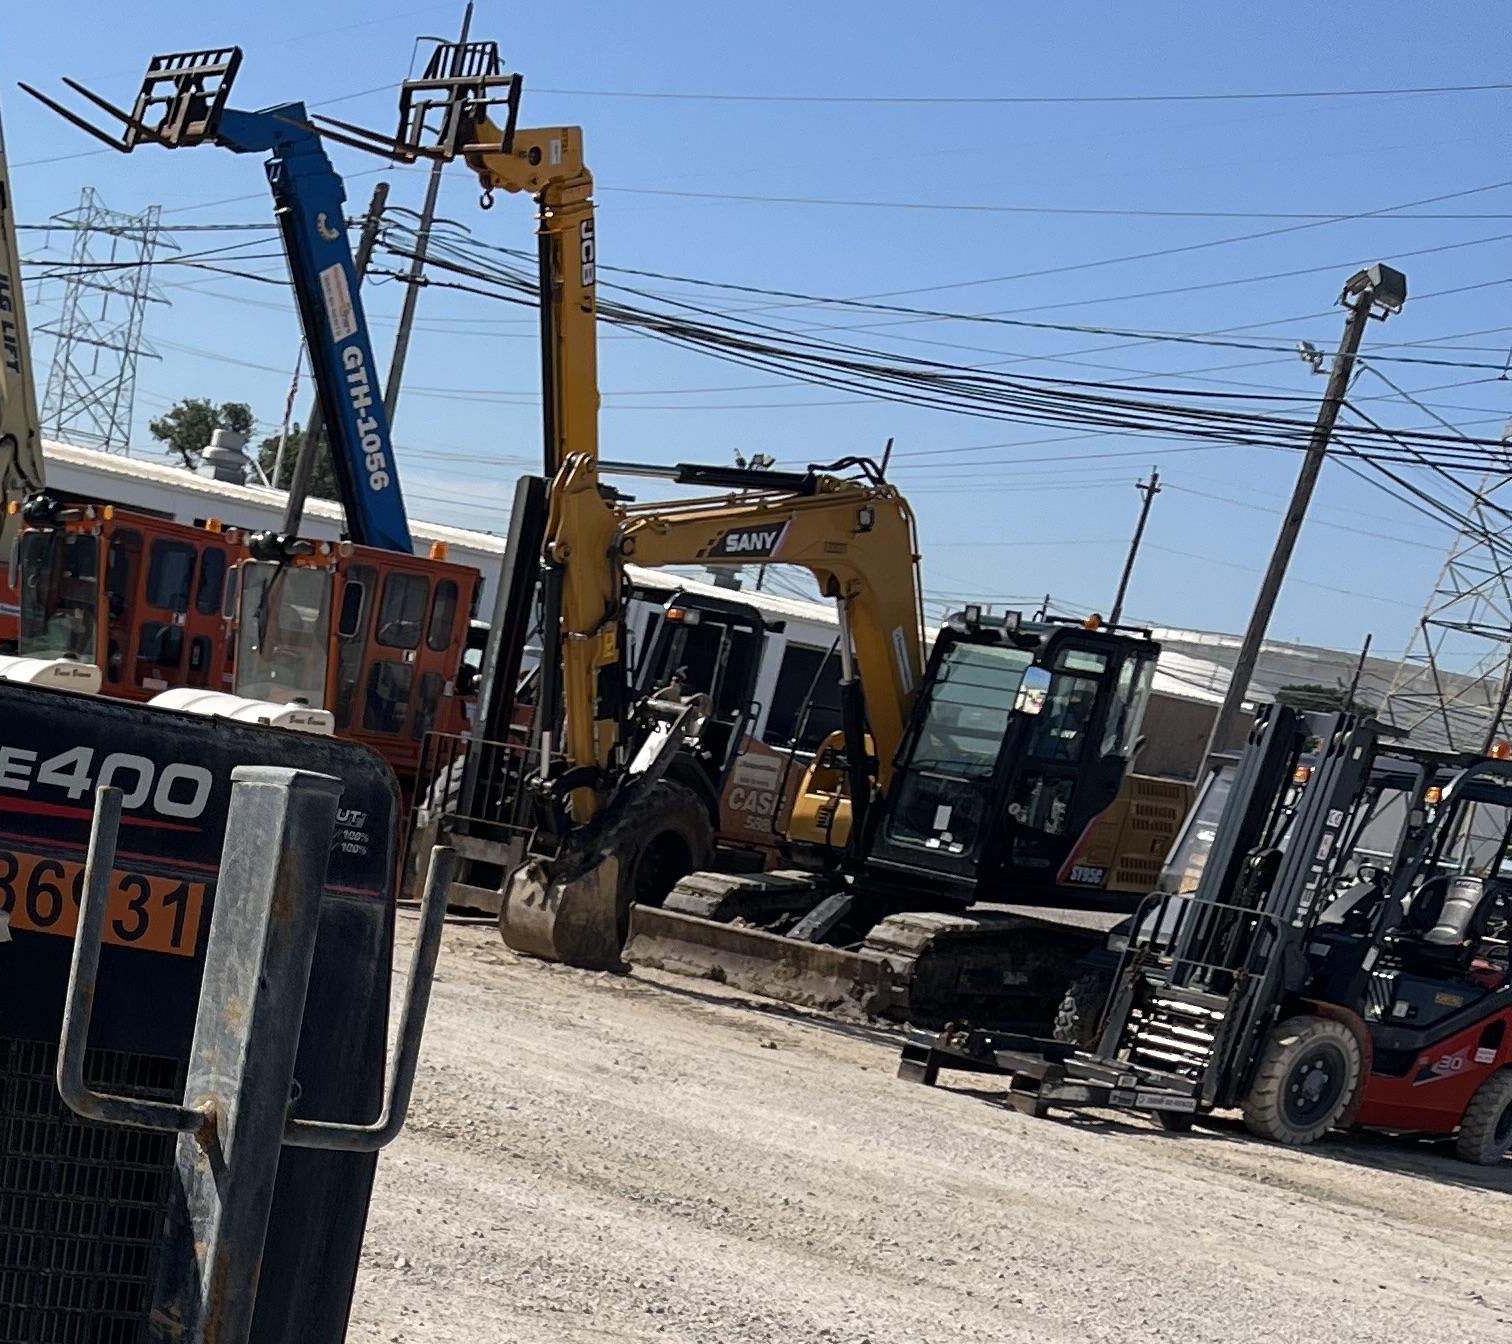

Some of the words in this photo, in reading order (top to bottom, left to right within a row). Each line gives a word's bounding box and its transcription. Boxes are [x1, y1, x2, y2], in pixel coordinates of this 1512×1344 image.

[581, 220, 594, 288] JCB
[1, 321, 20, 374] LIFT
[342, 345, 389, 492] GTH-1056
[725, 529, 778, 553] SANY
[1439, 1055, 1463, 1070] 30
